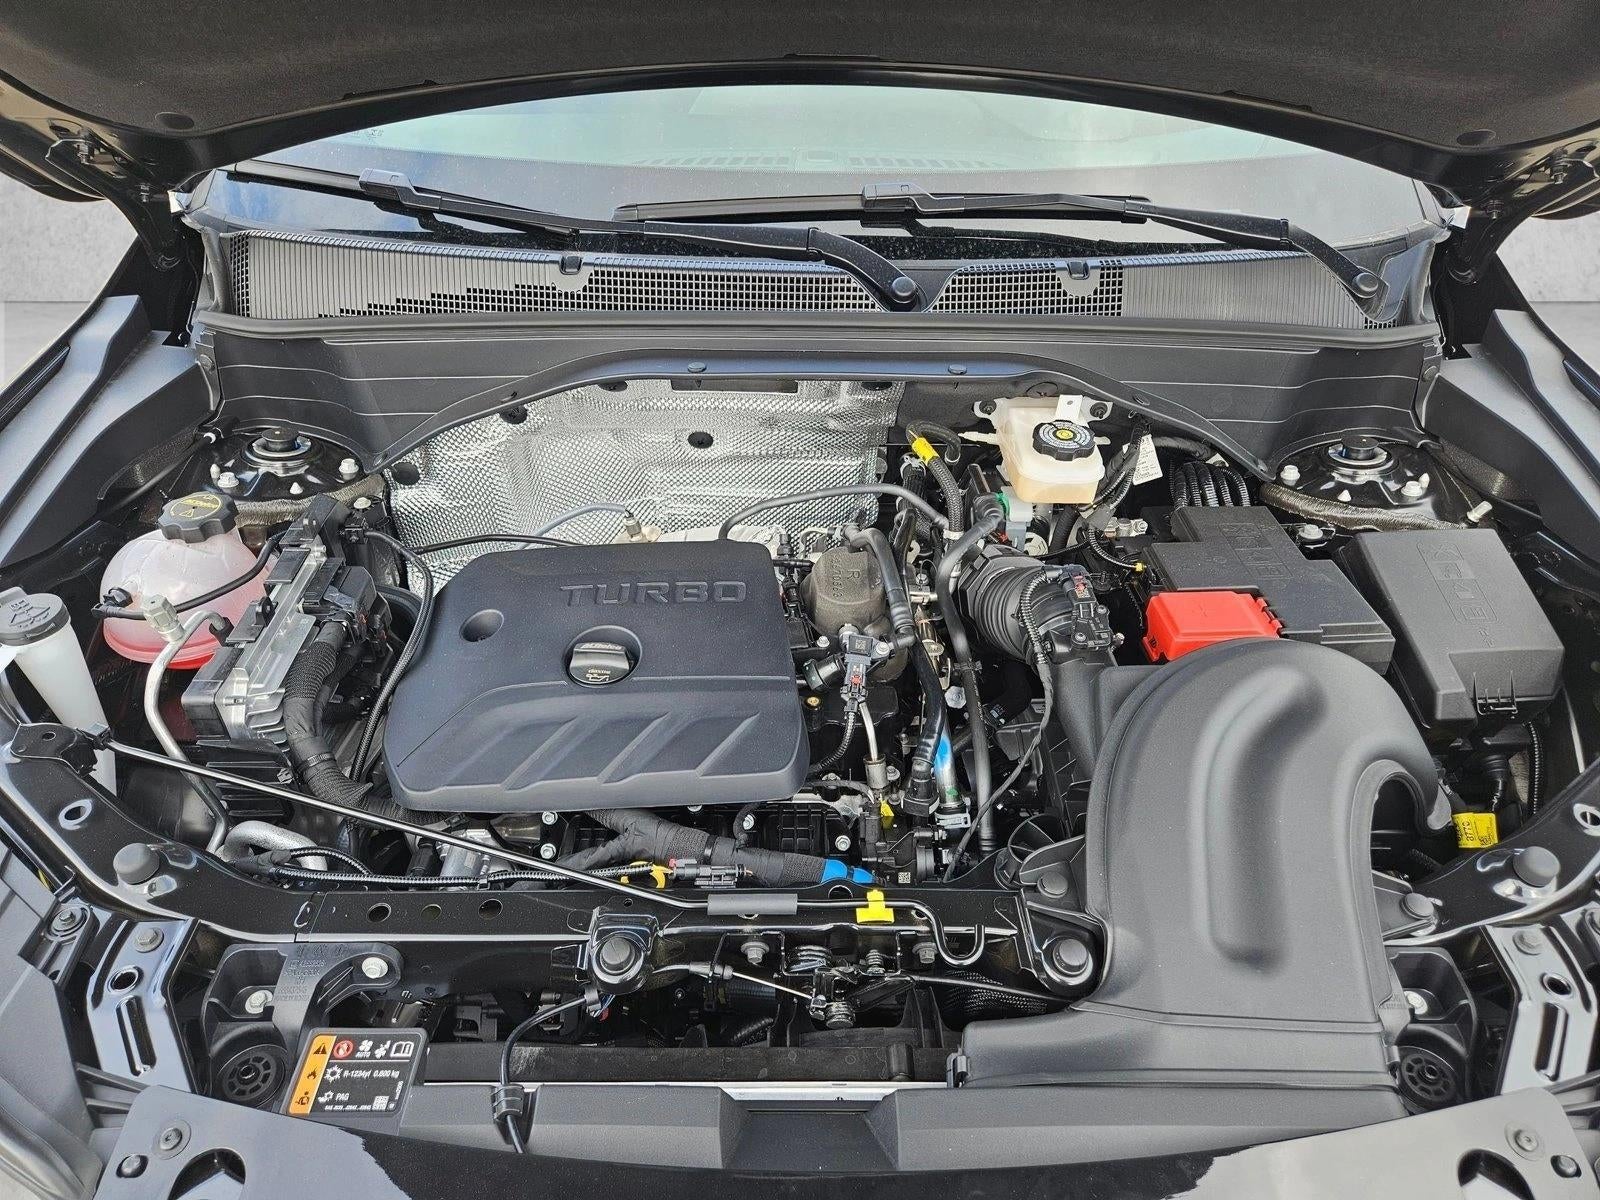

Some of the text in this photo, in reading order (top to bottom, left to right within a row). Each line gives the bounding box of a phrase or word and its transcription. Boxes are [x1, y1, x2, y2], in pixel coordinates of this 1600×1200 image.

[560, 581, 747, 606] TURBO
[355, 1051, 371, 1059] AUTO
[335, 1092, 350, 1101] PAG
